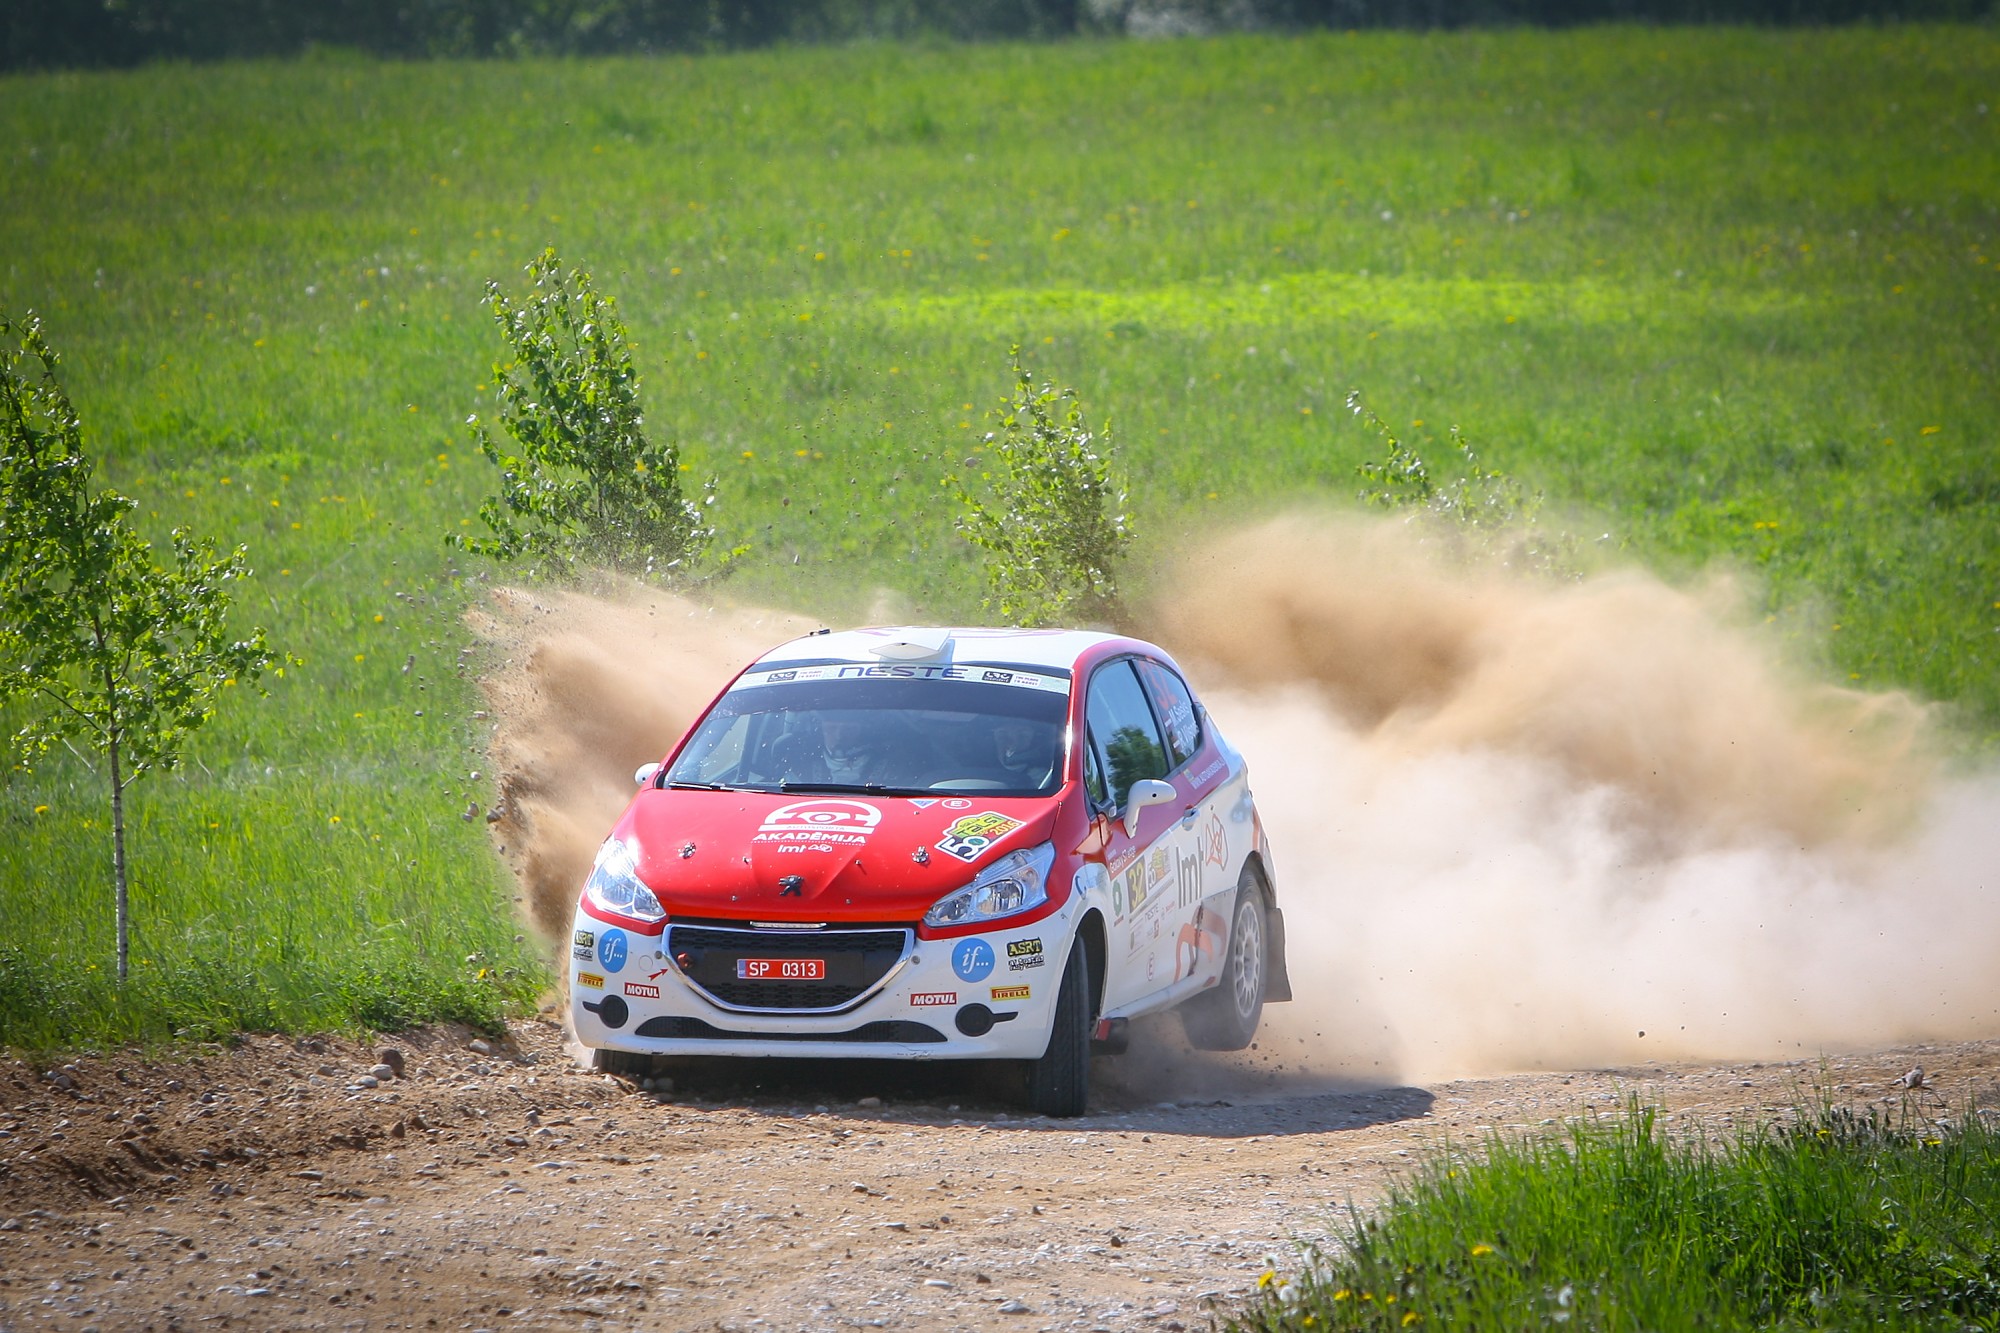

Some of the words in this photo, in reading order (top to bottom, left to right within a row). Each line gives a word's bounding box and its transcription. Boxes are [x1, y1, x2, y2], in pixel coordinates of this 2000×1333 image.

[838, 666, 969, 678] NESTE
[990, 820, 1020, 836] 2016
[752, 832, 866, 843] AKADĒMIJA
[1128, 861, 1146, 910] 32
[1009, 940, 1041, 955] ASRT
[749, 962, 769, 976] SP
[782, 962, 816, 977] 0313
[626, 984, 659, 998] MOTUL
[991, 986, 1029, 999] PIRELLI
[913, 994, 955, 1005] MOTUL
